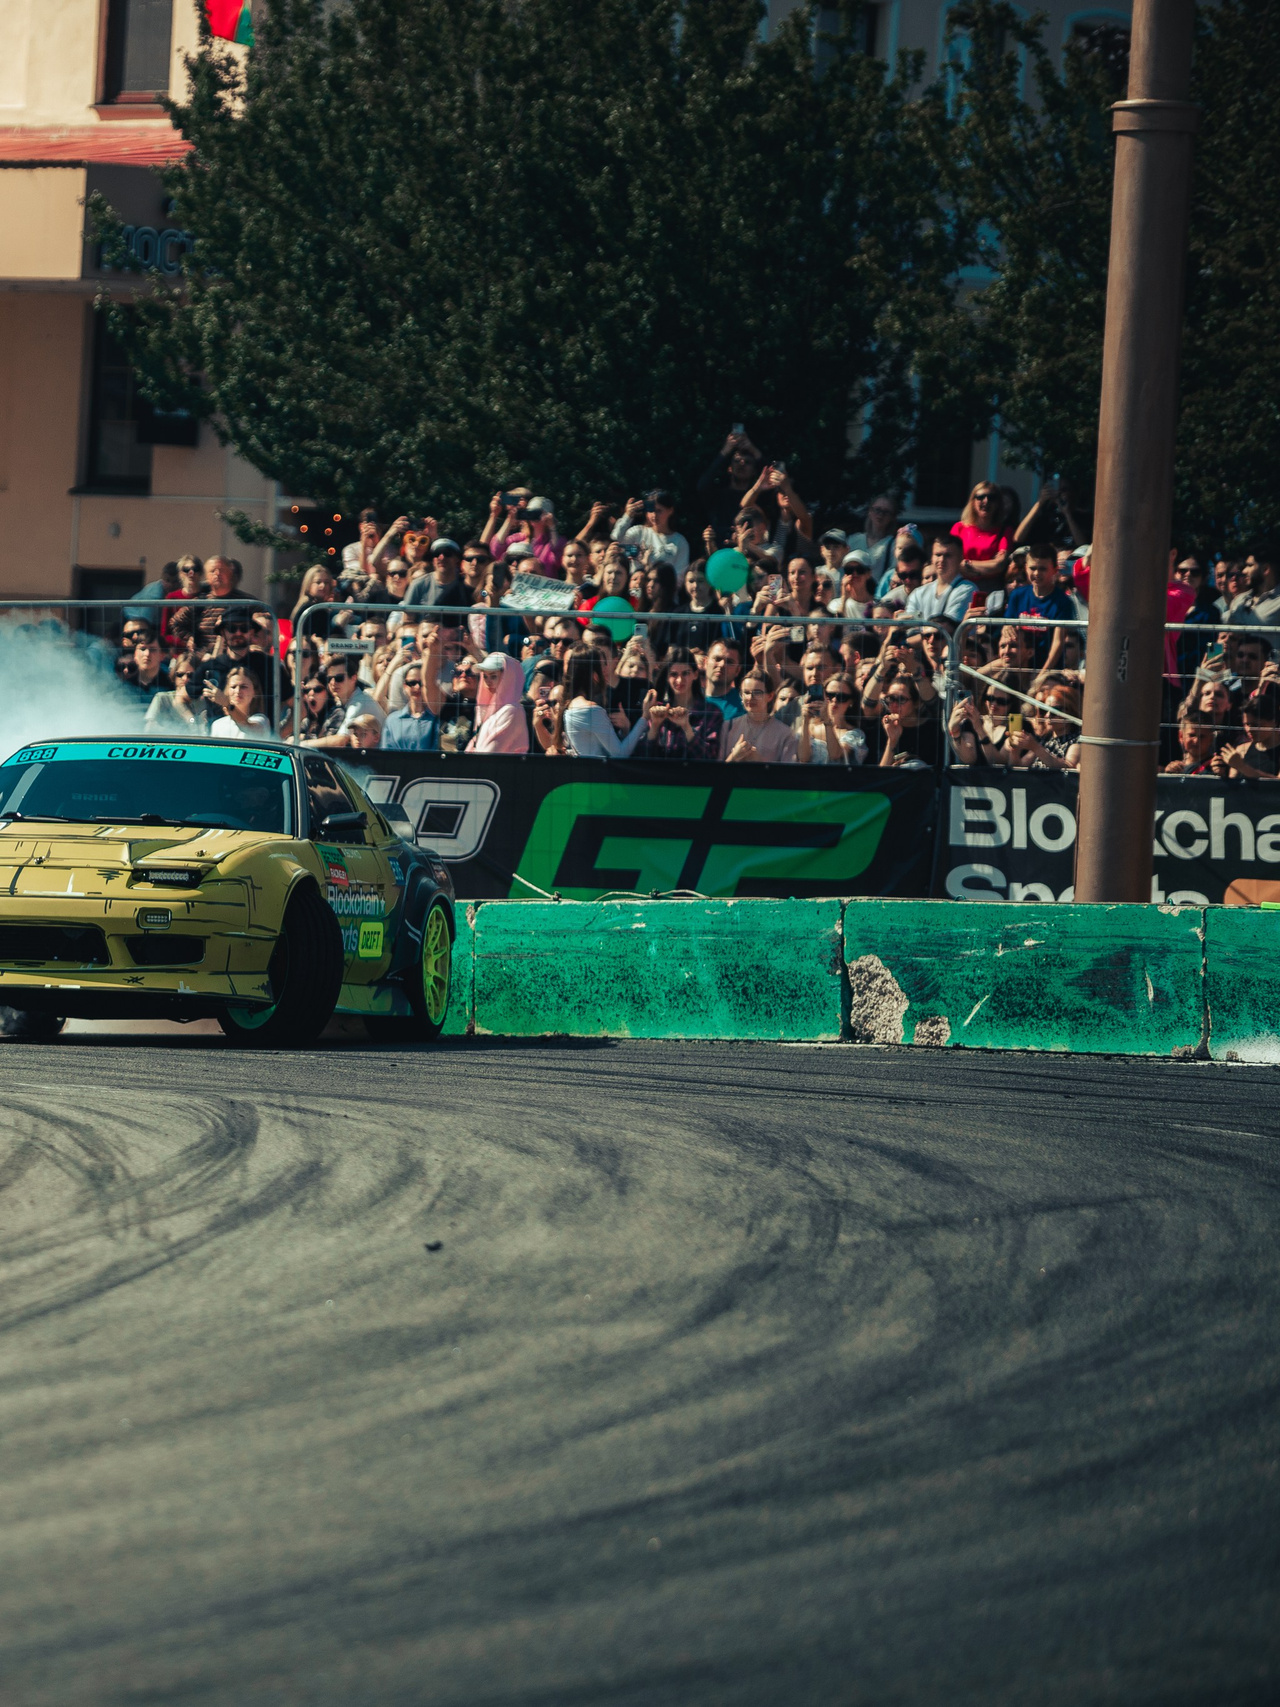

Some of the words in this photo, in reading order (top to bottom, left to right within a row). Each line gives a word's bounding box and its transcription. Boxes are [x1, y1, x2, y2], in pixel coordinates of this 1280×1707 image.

[20, 748, 55, 761] 888
[107, 744, 187, 760] СОЙКО
[71, 793, 118, 802] BRIDE
[507, 781, 892, 899] GP
[327, 885, 379, 916] Blockchain
[361, 931, 380, 951] DRIFT
